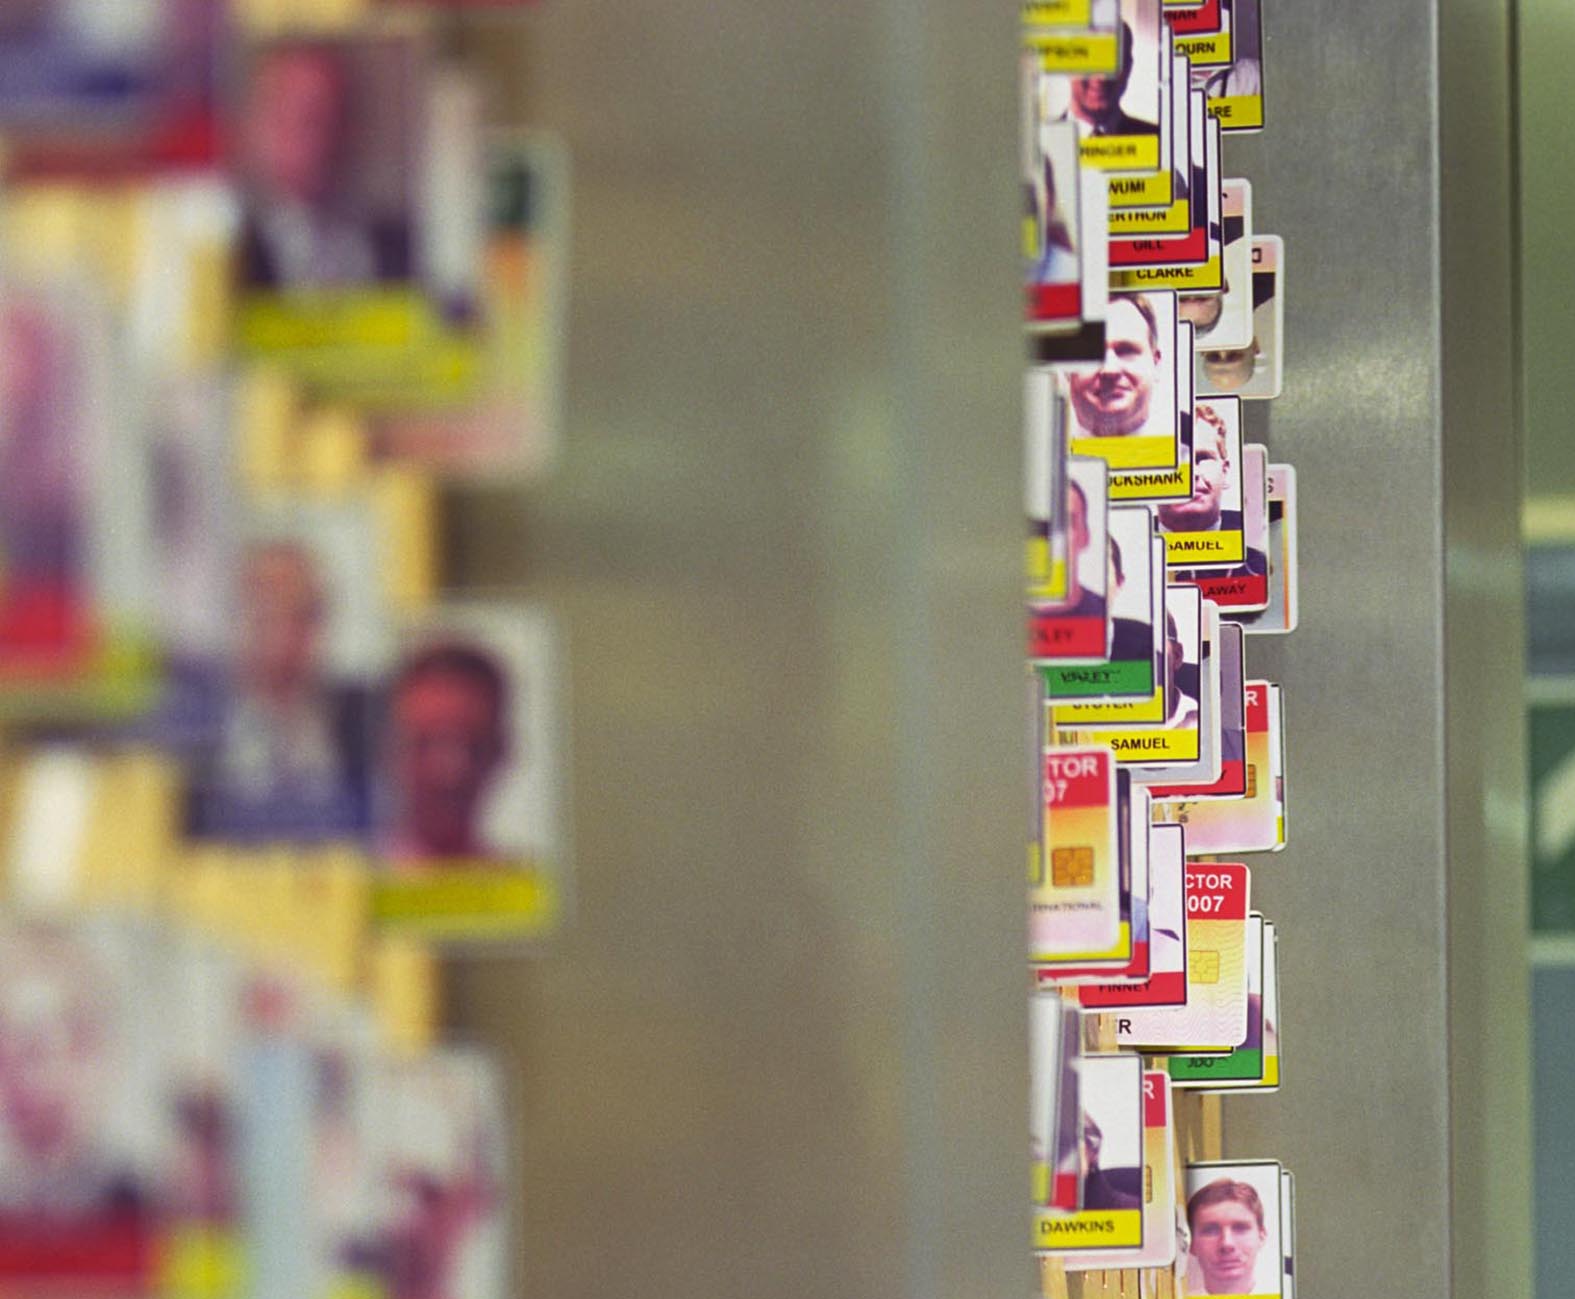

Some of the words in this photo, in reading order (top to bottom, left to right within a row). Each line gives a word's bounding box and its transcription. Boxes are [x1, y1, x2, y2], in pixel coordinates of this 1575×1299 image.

[1111, 738, 1170, 750] SAMUEL
[1186, 873, 1233, 890] CTOR
[1188, 895, 1225, 912] 007
[1041, 1220, 1115, 1234] DAWKINS
